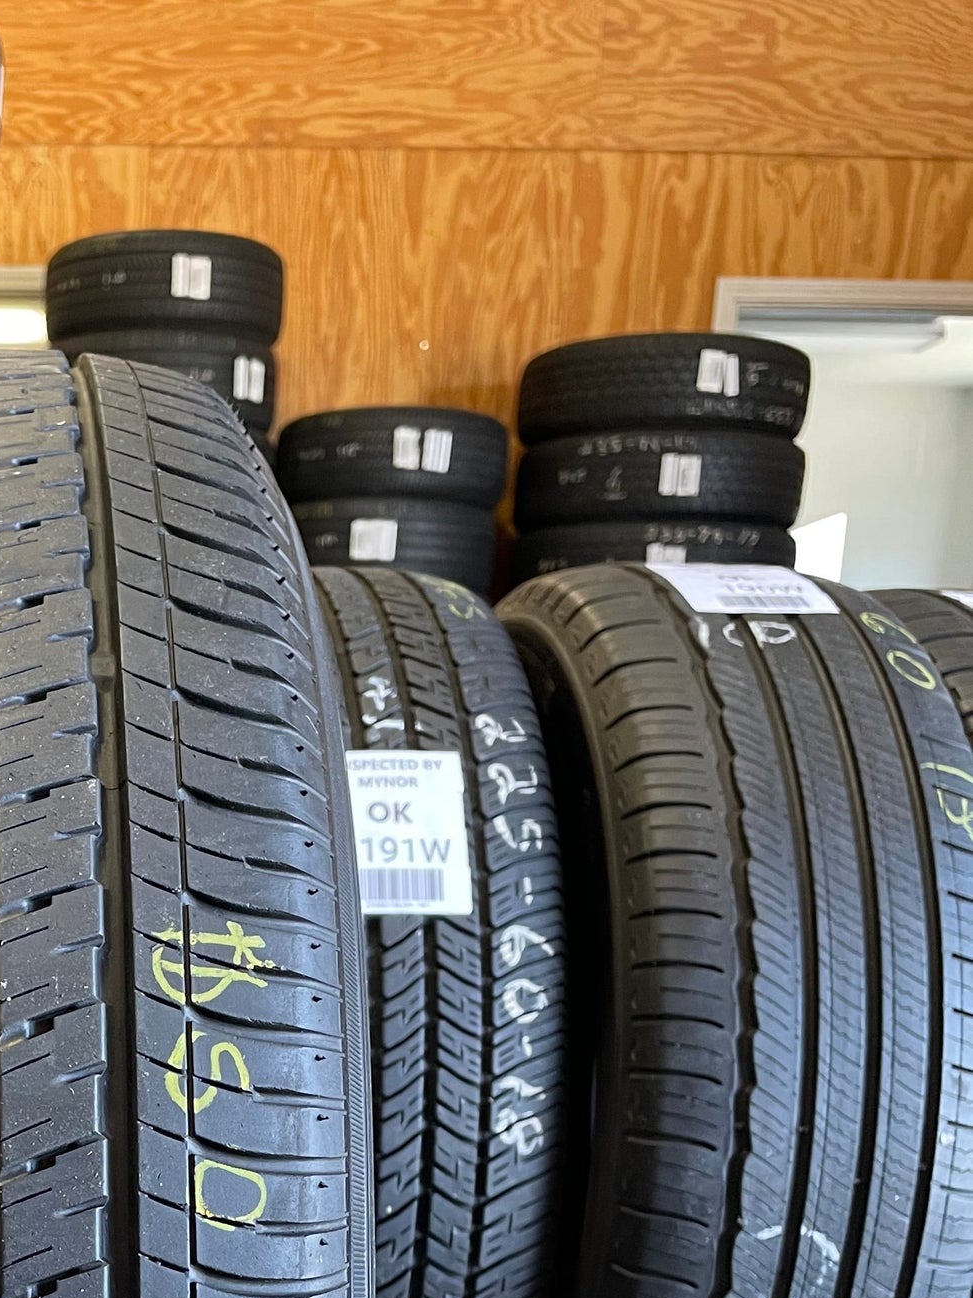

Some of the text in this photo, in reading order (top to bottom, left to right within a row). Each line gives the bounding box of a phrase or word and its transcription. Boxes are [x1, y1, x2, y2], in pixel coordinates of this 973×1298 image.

[347, 759, 443, 771] SPECTED BY
[357, 776, 418, 788] MYNOR
[367, 802, 412, 824] OK
[360, 836, 451, 864] 191W
